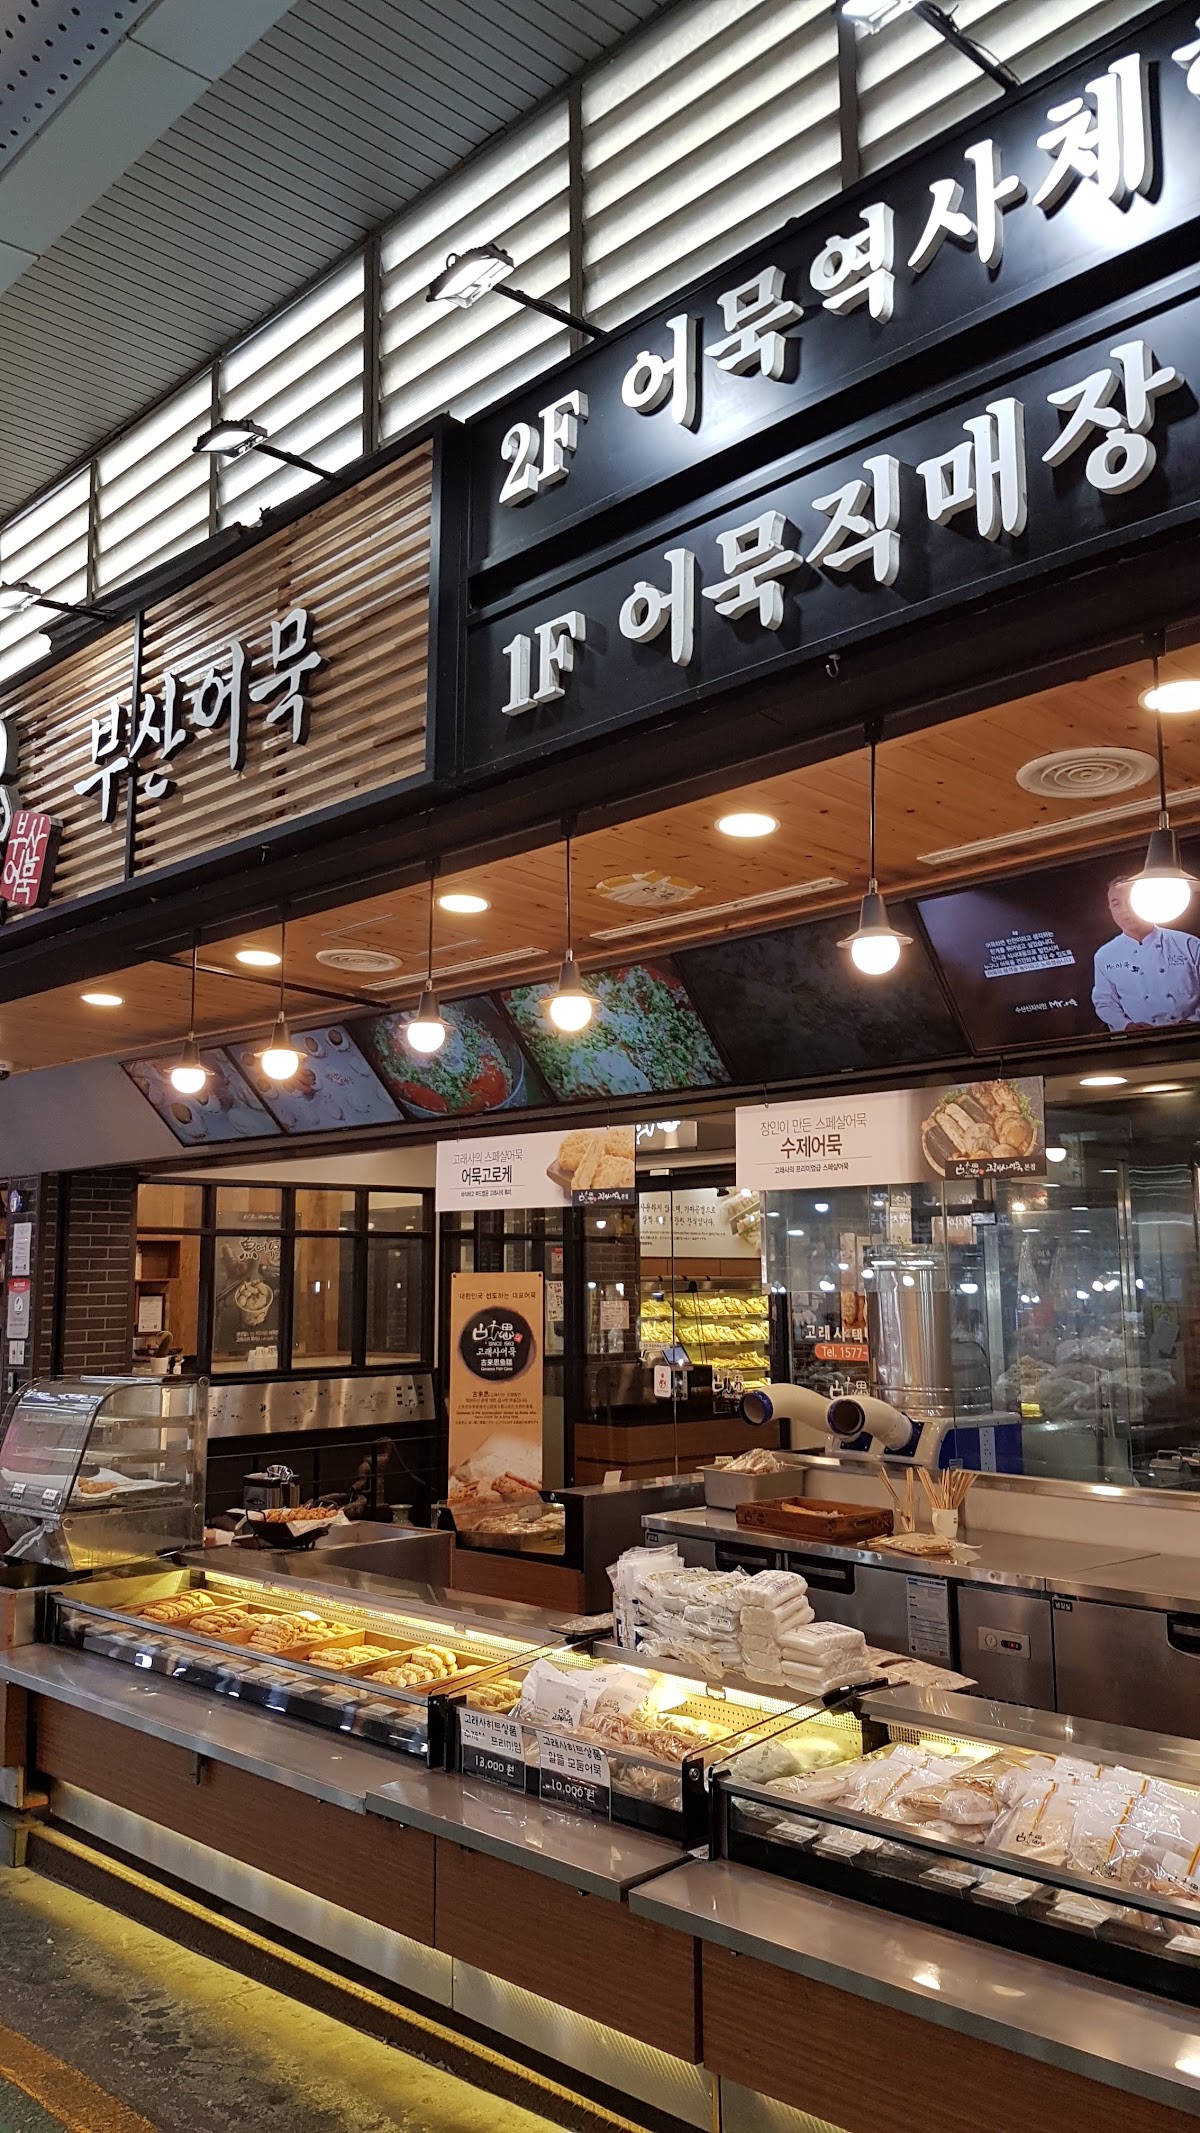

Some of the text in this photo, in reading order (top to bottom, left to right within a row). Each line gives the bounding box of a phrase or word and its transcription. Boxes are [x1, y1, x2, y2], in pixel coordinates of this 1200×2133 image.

[499, 390, 588, 505] 2F
[501, 611, 585, 716] 1F
[74, 608, 322, 823] 부산어묵
[760, 1119, 789, 1137] 장인이
[791, 1117, 812, 1134] 만든
[780, 1134, 843, 1159] 수제어묵
[452, 1151, 483, 1165] 고래사의
[461, 1164, 512, 1186] 어묵고로케
[476, 1346, 517, 1357] 고래사어묵
[821, 1345, 838, 1358] Tel.
[464, 1713, 518, 1737] 고래사히트상품
[491, 1736, 522, 1754] 프리미엄
[542, 1736, 602, 1761] 고래사히트상품
[475, 1755, 504, 1773] 13,000
[507, 1764, 515, 1778] 원
[552, 1779, 583, 1798] 10,000
